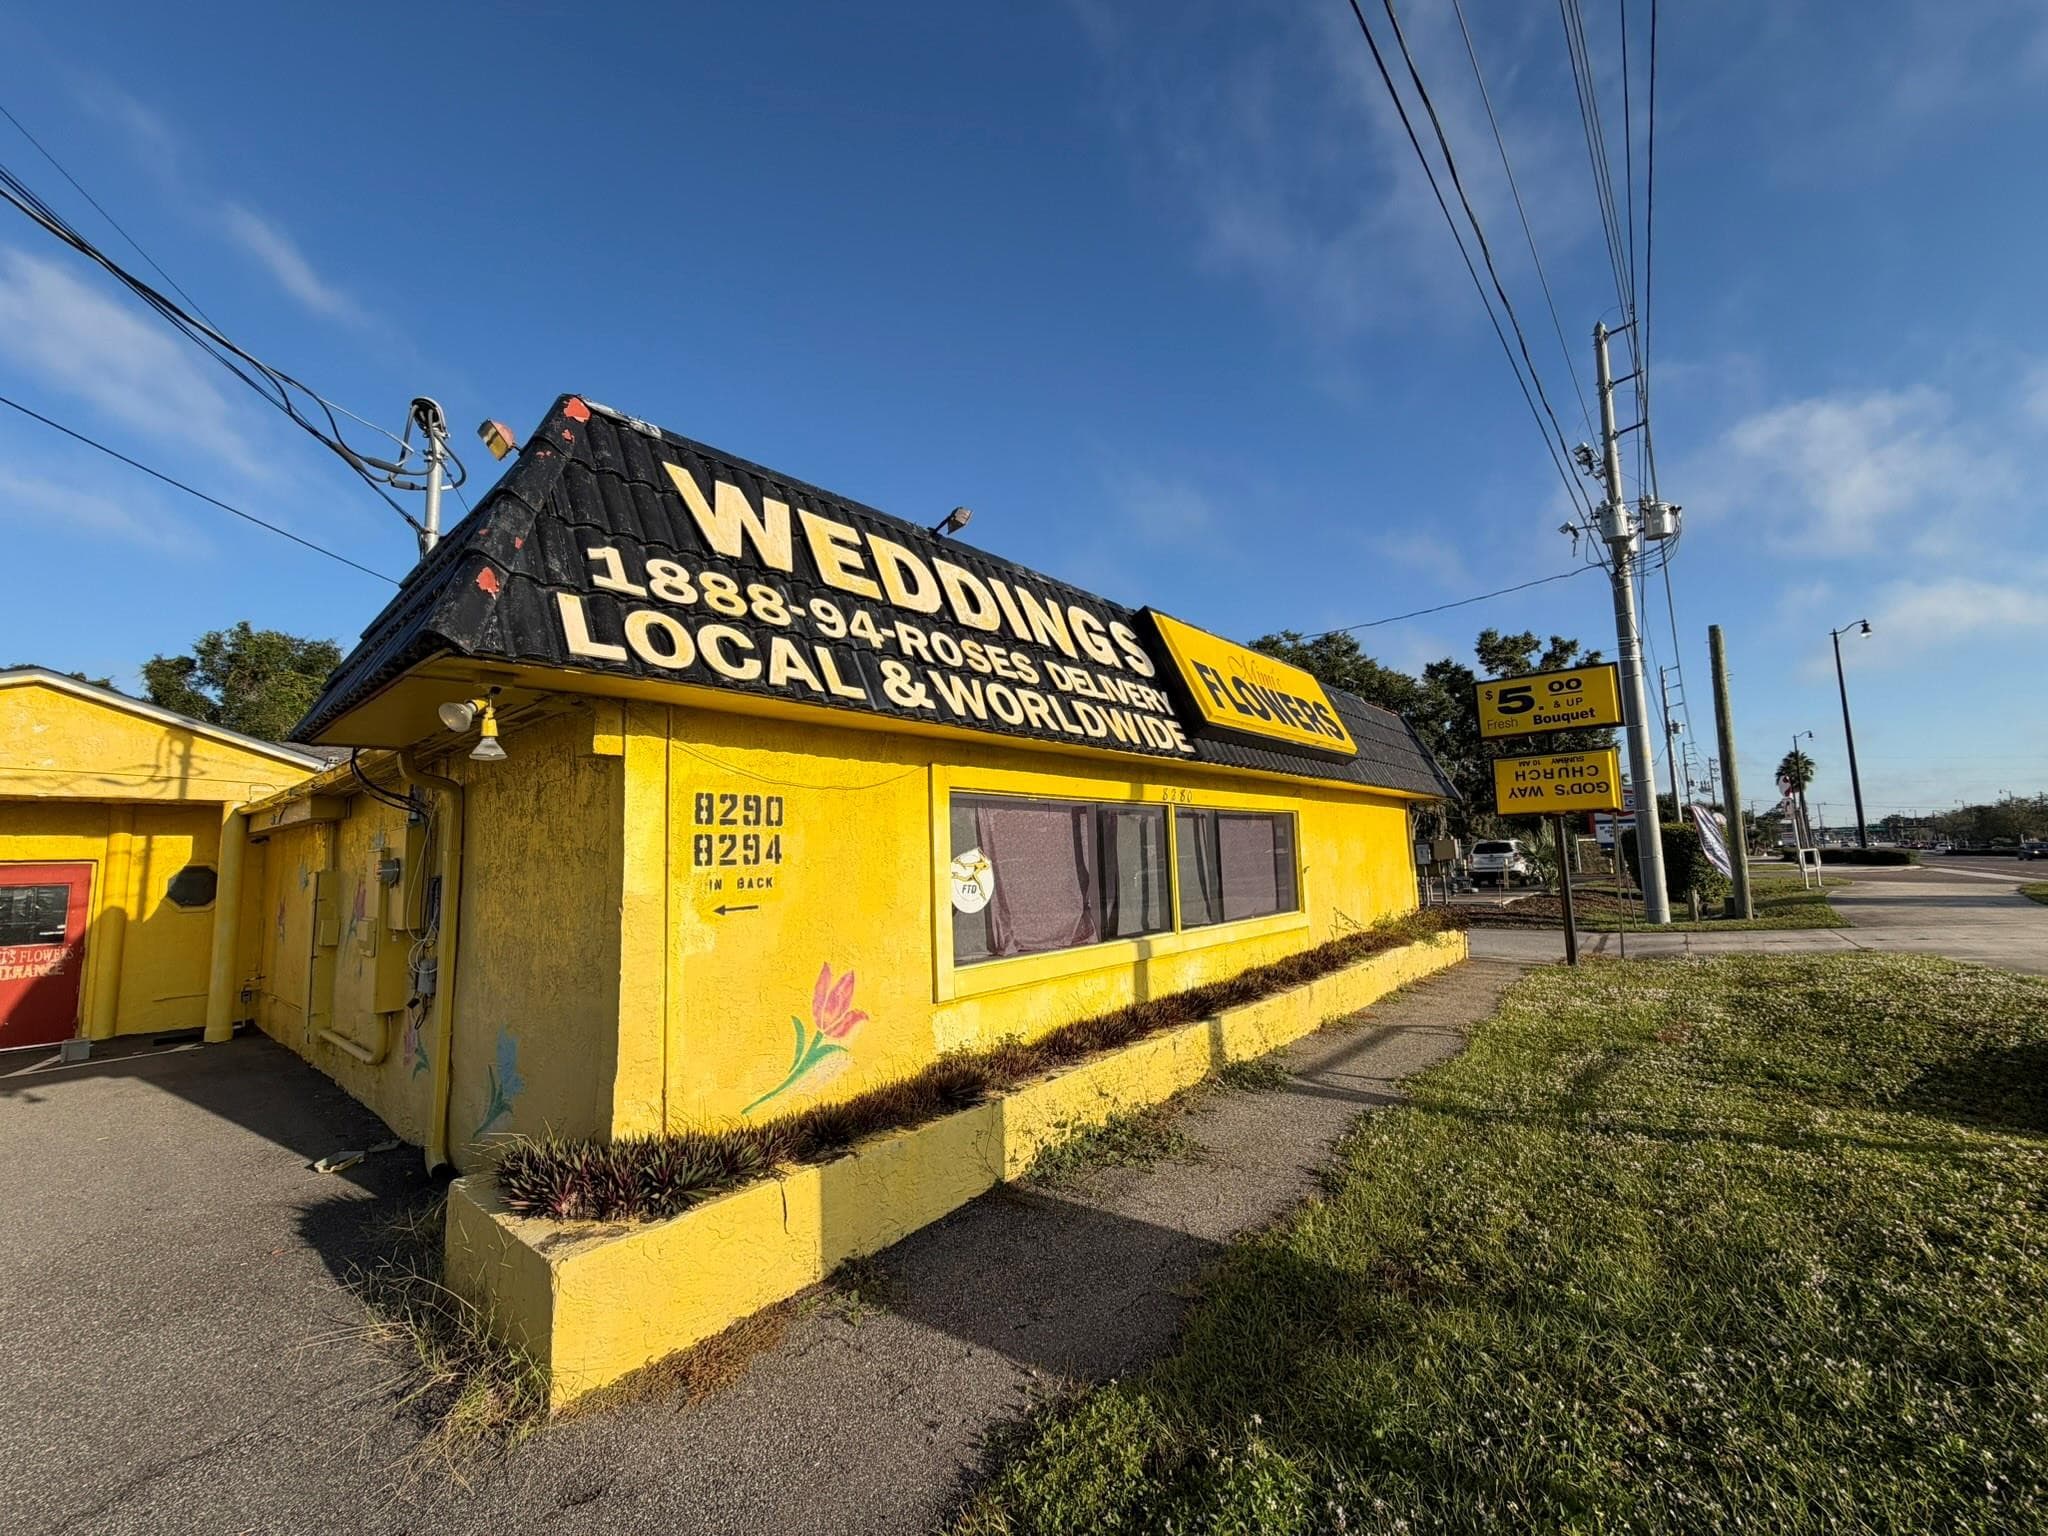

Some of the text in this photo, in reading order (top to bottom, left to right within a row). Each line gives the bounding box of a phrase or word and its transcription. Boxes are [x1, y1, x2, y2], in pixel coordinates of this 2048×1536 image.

[663, 461, 1156, 678] WEDDINGS
[588, 546, 1175, 716] 1888-94-ROSES DELIVERY
[557, 592, 1196, 753] LOCAL & WORLDWIDE
[1190, 659, 1346, 742] FLOWERS
[1553, 697, 1583, 709] & UP
[1487, 707, 1596, 730] Fresh Bouquet
[1514, 764, 1600, 782] CHURCH
[1508, 781, 1610, 799] GOD'S WAY
[694, 792, 784, 827] 8290
[694, 833, 782, 867] 8294
[709, 876, 773, 892] IN BACK
[962, 884, 977, 895] FTD
[19, 947, 74, 963] FLOWERS
